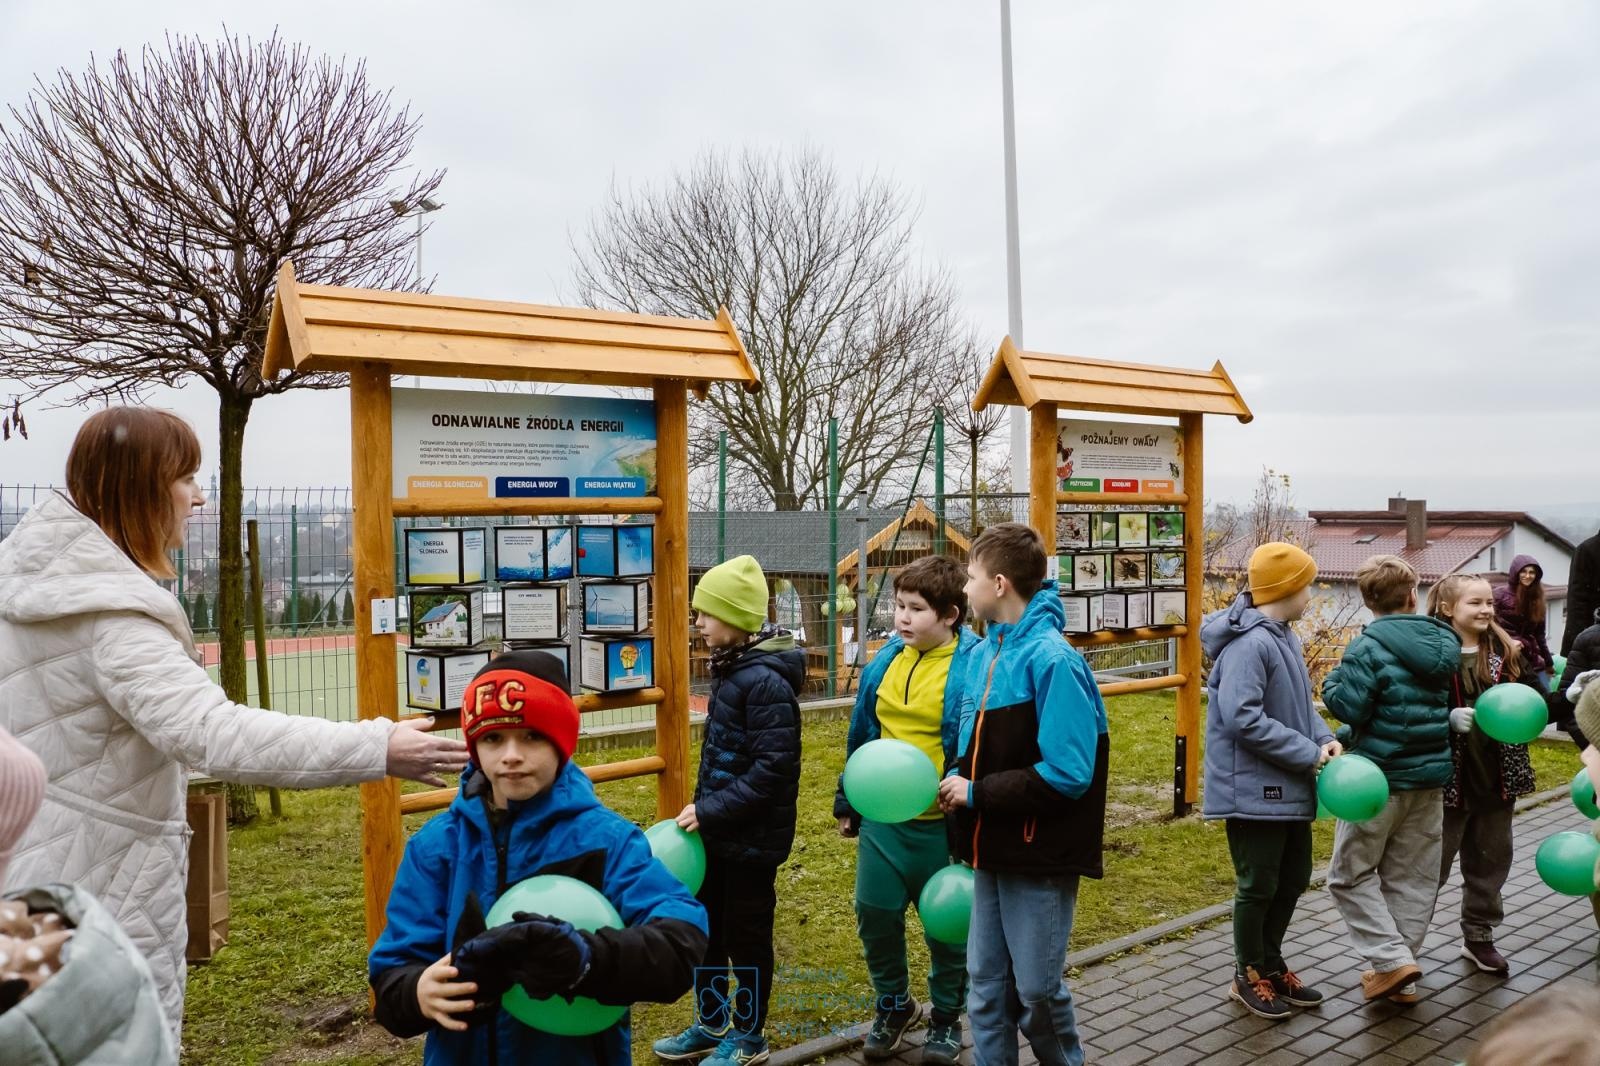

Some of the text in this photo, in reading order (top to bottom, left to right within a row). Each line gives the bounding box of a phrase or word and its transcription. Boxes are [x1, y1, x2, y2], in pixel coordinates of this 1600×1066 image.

[432, 414, 624, 432] ODNAWIALNE ŹRÓDŁA ENERGII
[1133, 434, 1159, 448] OWADY
